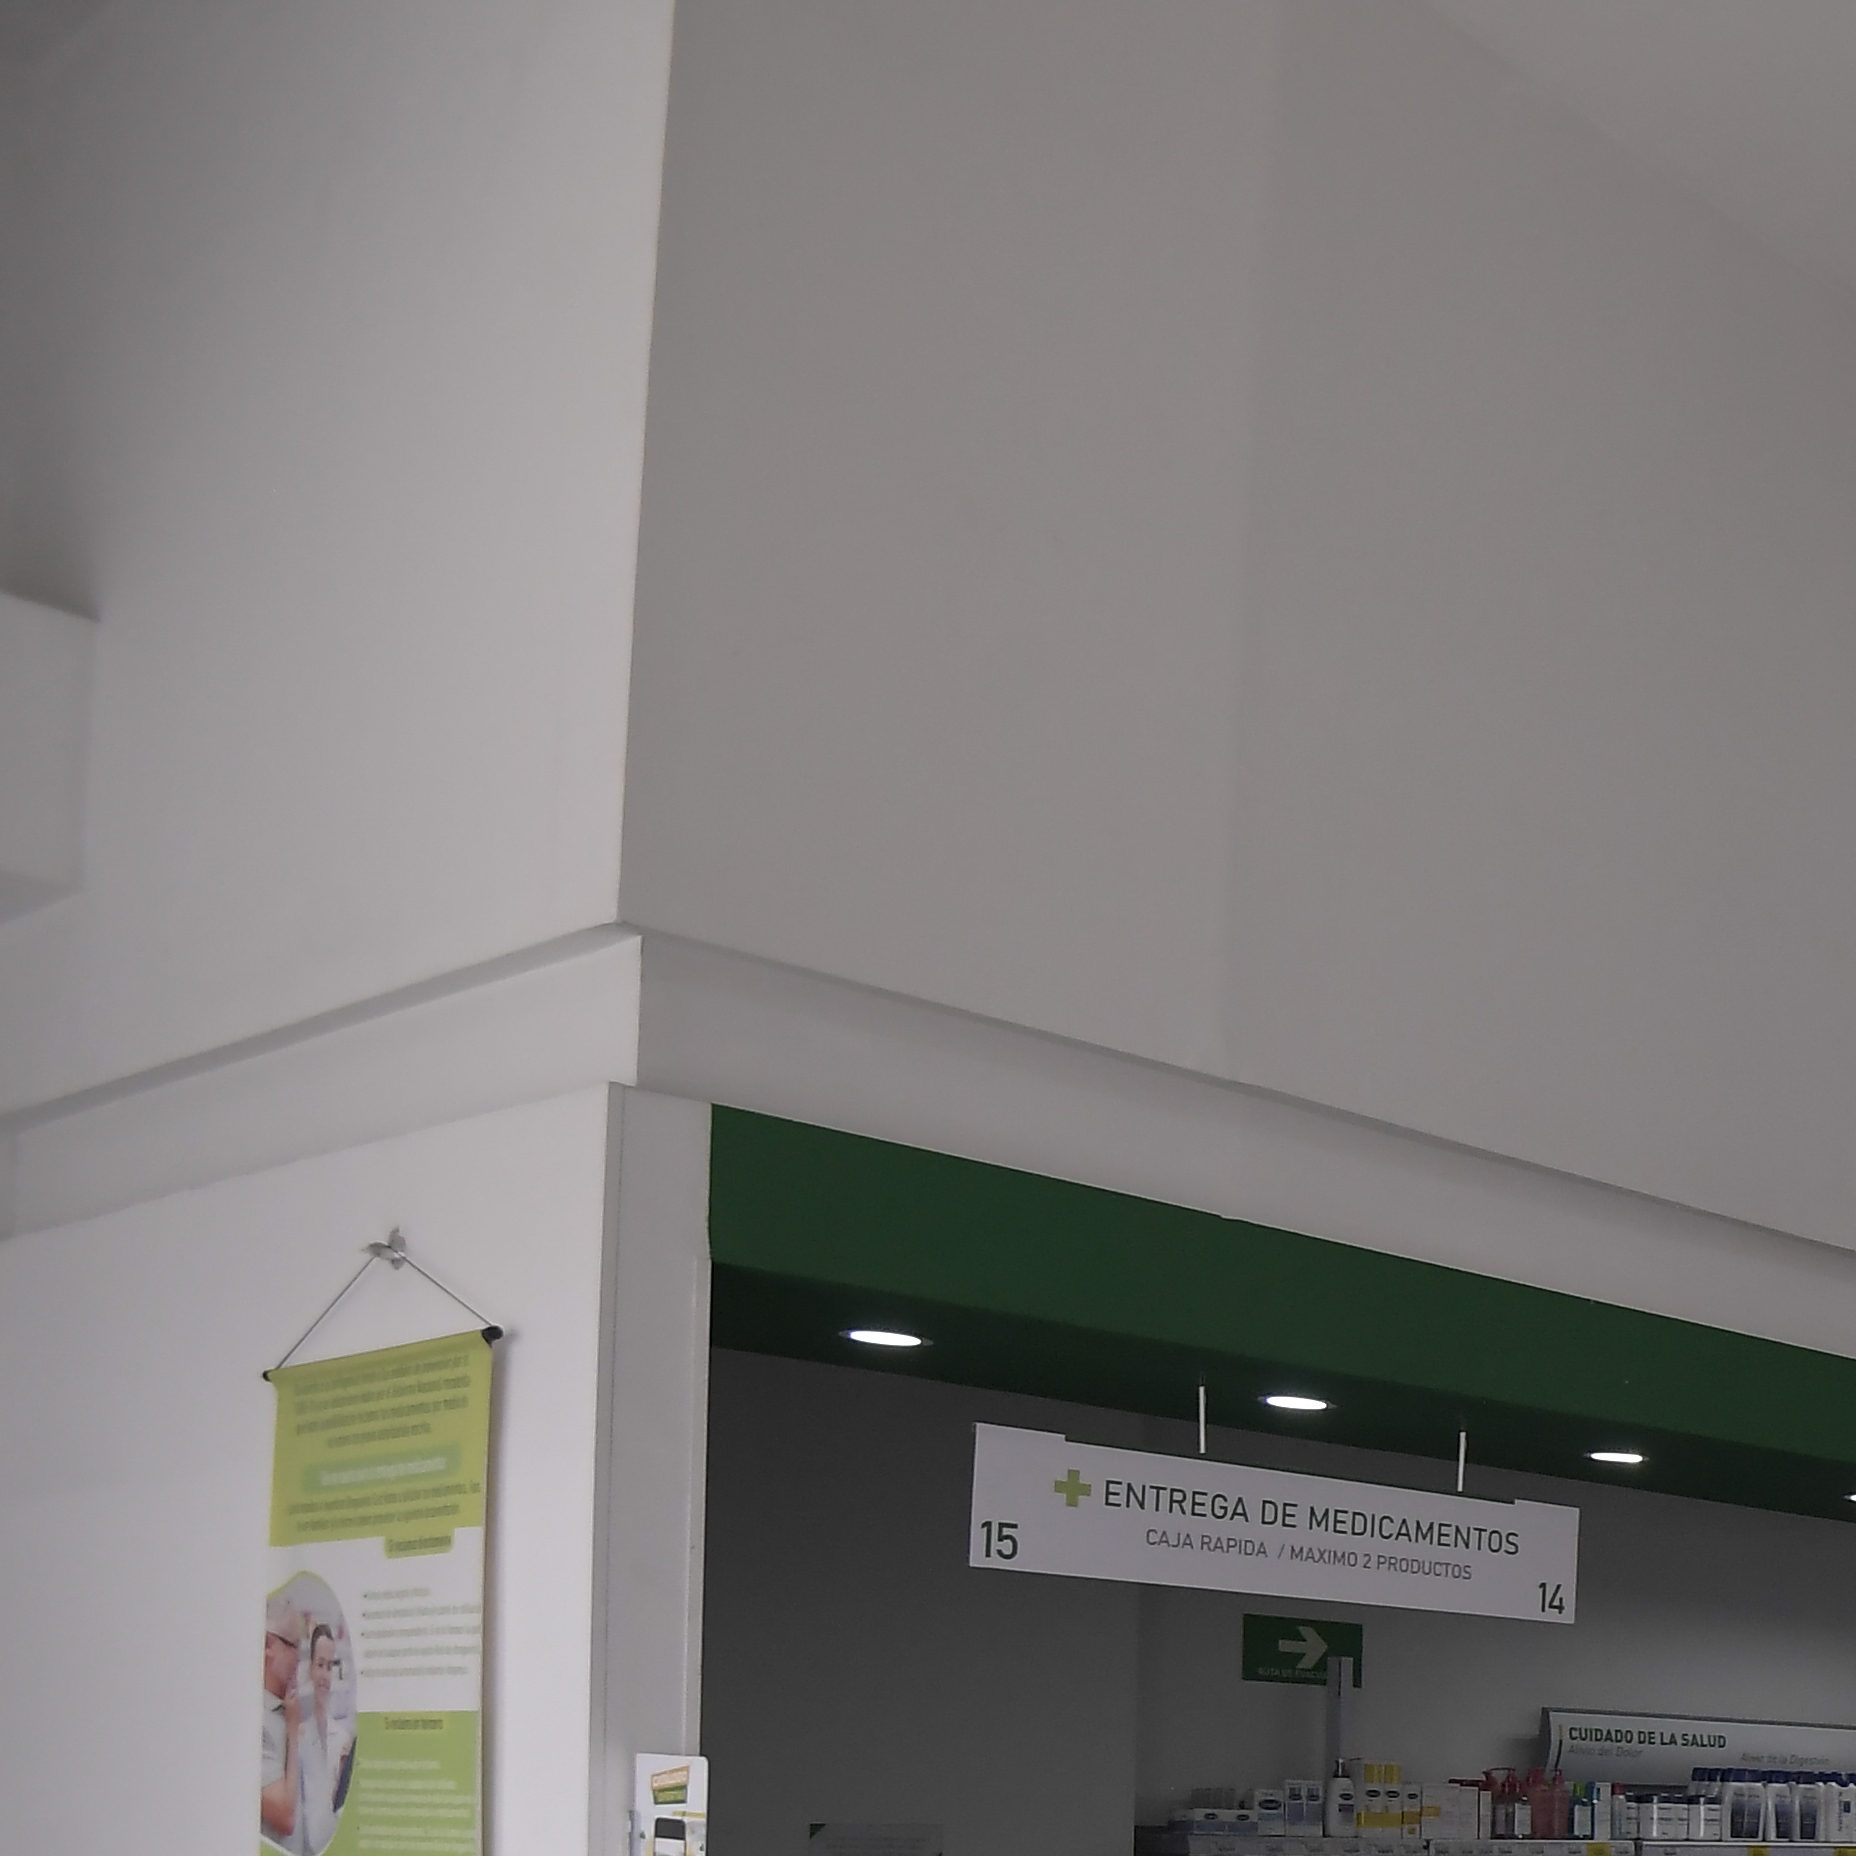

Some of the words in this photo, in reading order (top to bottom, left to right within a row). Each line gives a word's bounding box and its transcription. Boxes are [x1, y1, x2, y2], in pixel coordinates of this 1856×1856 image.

[1104, 1480, 1248, 1523] ENTREGA
[1261, 1502, 1297, 1529] DE
[1309, 1507, 1519, 1556] MEDICAMENTOS
[980, 1521, 1019, 1560] 15
[1145, 1529, 1193, 1551] CAJA
[1201, 1534, 1268, 1558] RAPIDA
[1290, 1546, 1358, 1569] MAXIMO
[1363, 1553, 1372, 1570] 2
[1377, 1555, 1472, 1580] PRODUCTOS
[1537, 1583, 1565, 1614] 14
[1569, 1726, 1633, 1745] CUIDADO
[1636, 1729, 1656, 1745] DE
[1660, 1731, 1678, 1747] LA
[1681, 1732, 1726, 1749] SALUD
